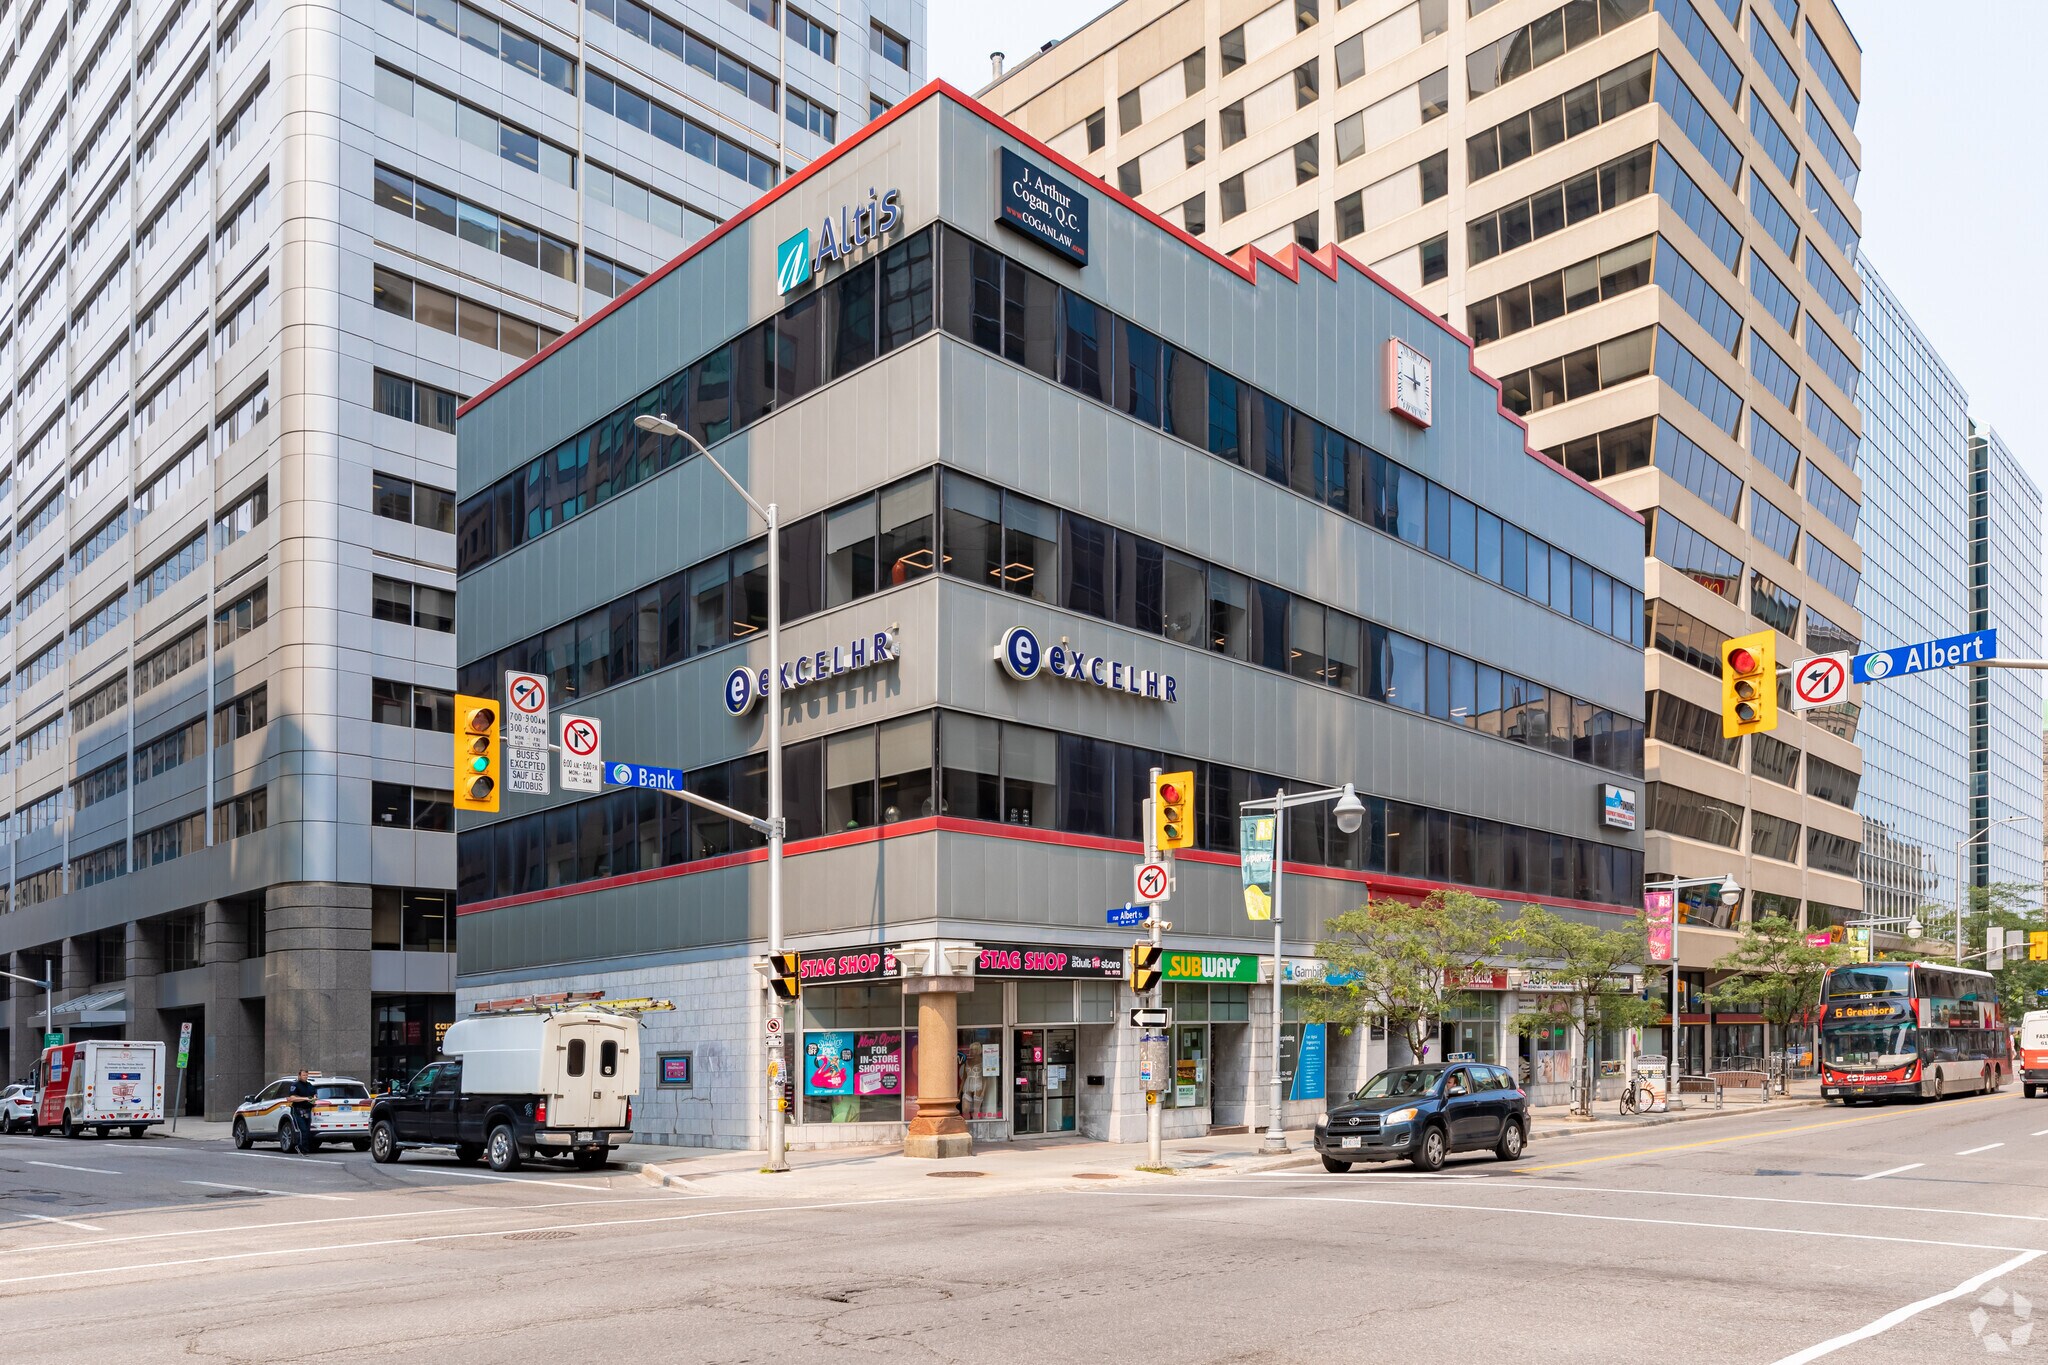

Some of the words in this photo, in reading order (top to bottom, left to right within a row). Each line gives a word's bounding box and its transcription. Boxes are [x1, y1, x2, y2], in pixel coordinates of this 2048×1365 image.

[1023, 168, 1032, 186] J.
[1034, 176, 1071, 208] Arthur
[1013, 181, 1052, 219] Cogan,
[1055, 206, 1080, 233] Q.C.
[814, 186, 899, 272] Altis
[1904, 636, 1984, 673] Albert
[516, 749, 540, 760] BUSES
[510, 759, 546, 771] EXCEPTED
[512, 770, 529, 780] SAUF
[532, 772, 544, 782] LES
[639, 768, 675, 790] Bank
[513, 781, 543, 792] AUTOBUS
[1120, 911, 1138, 920] Albert
[801, 957, 836, 978] STAG
[839, 953, 880, 975] SHOP
[980, 949, 1021, 971] STAG
[1024, 952, 1068, 971] SHOP
[1071, 958, 1091, 968] adult
[1101, 959, 1120, 969] store
[1168, 955, 1241, 978] SUBWAY
[1847, 1006, 1895, 1017] Greenboro
[871, 1046, 888, 1054] FOR
[860, 1055, 899, 1064] IN-STORE
[859, 1064, 900, 1073] SHOPPING
